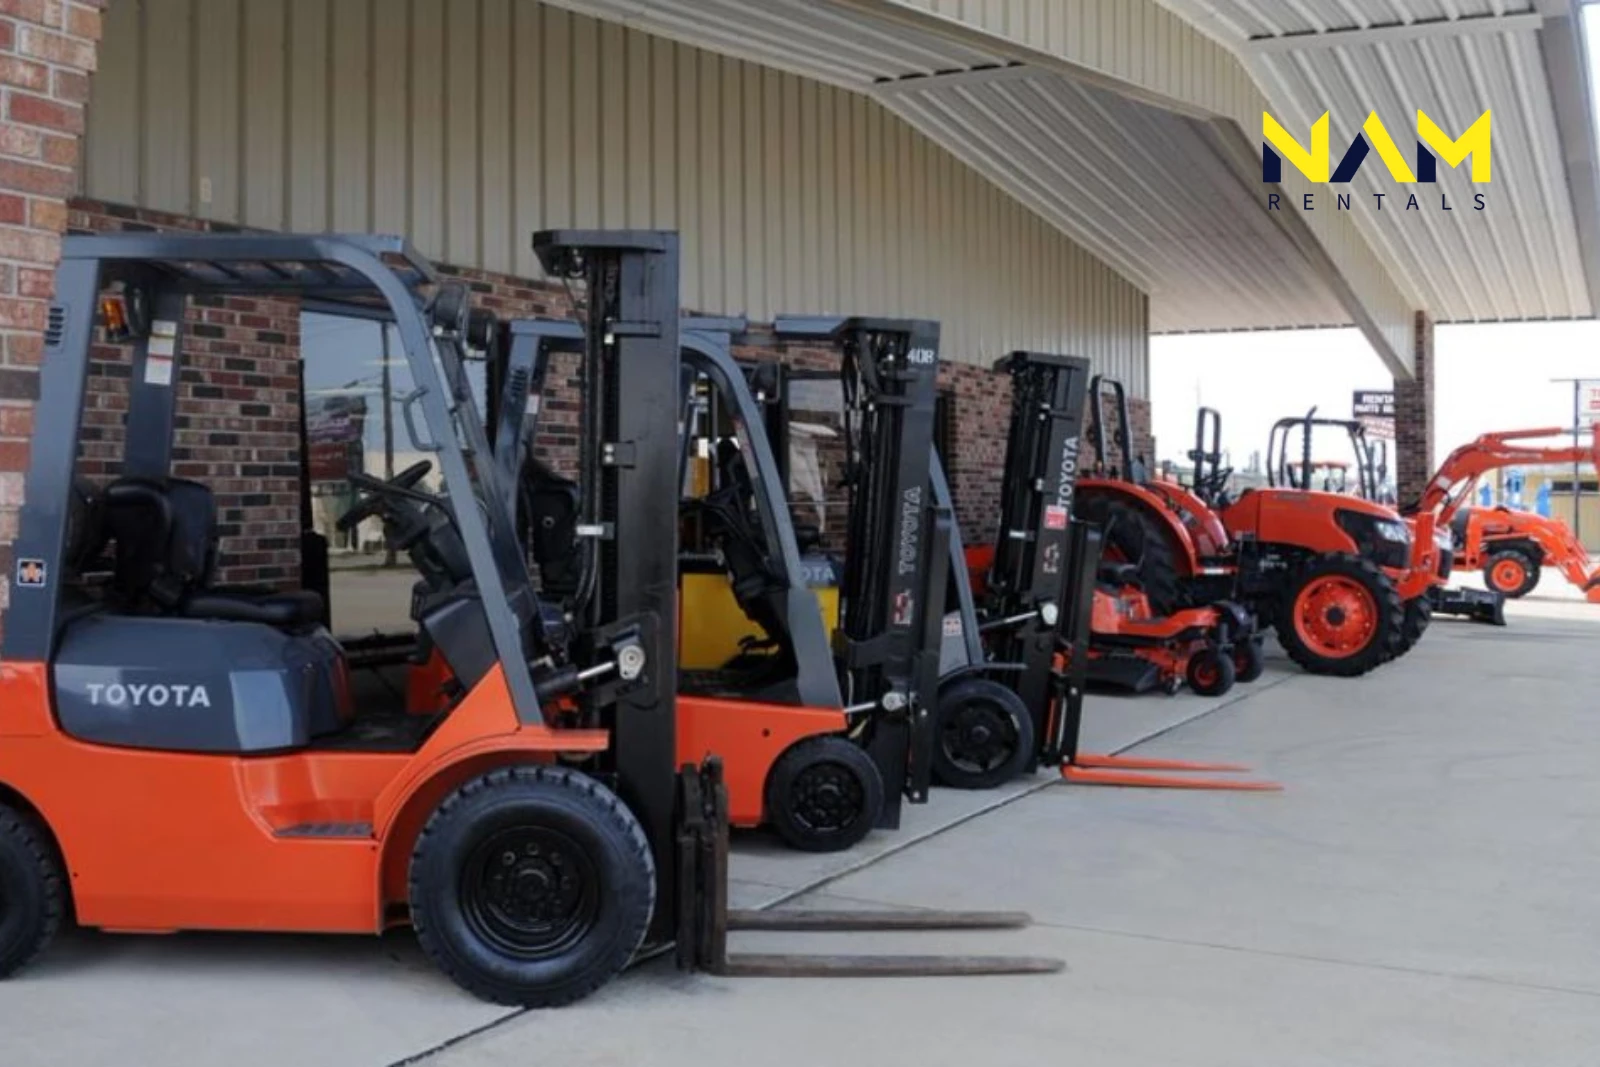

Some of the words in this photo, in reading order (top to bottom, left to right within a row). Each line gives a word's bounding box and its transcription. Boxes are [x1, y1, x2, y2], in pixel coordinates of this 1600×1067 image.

[1056, 436, 1079, 509] TOYOTA
[899, 485, 922, 575] TOYOTA
[86, 683, 211, 707] TOYOTA
